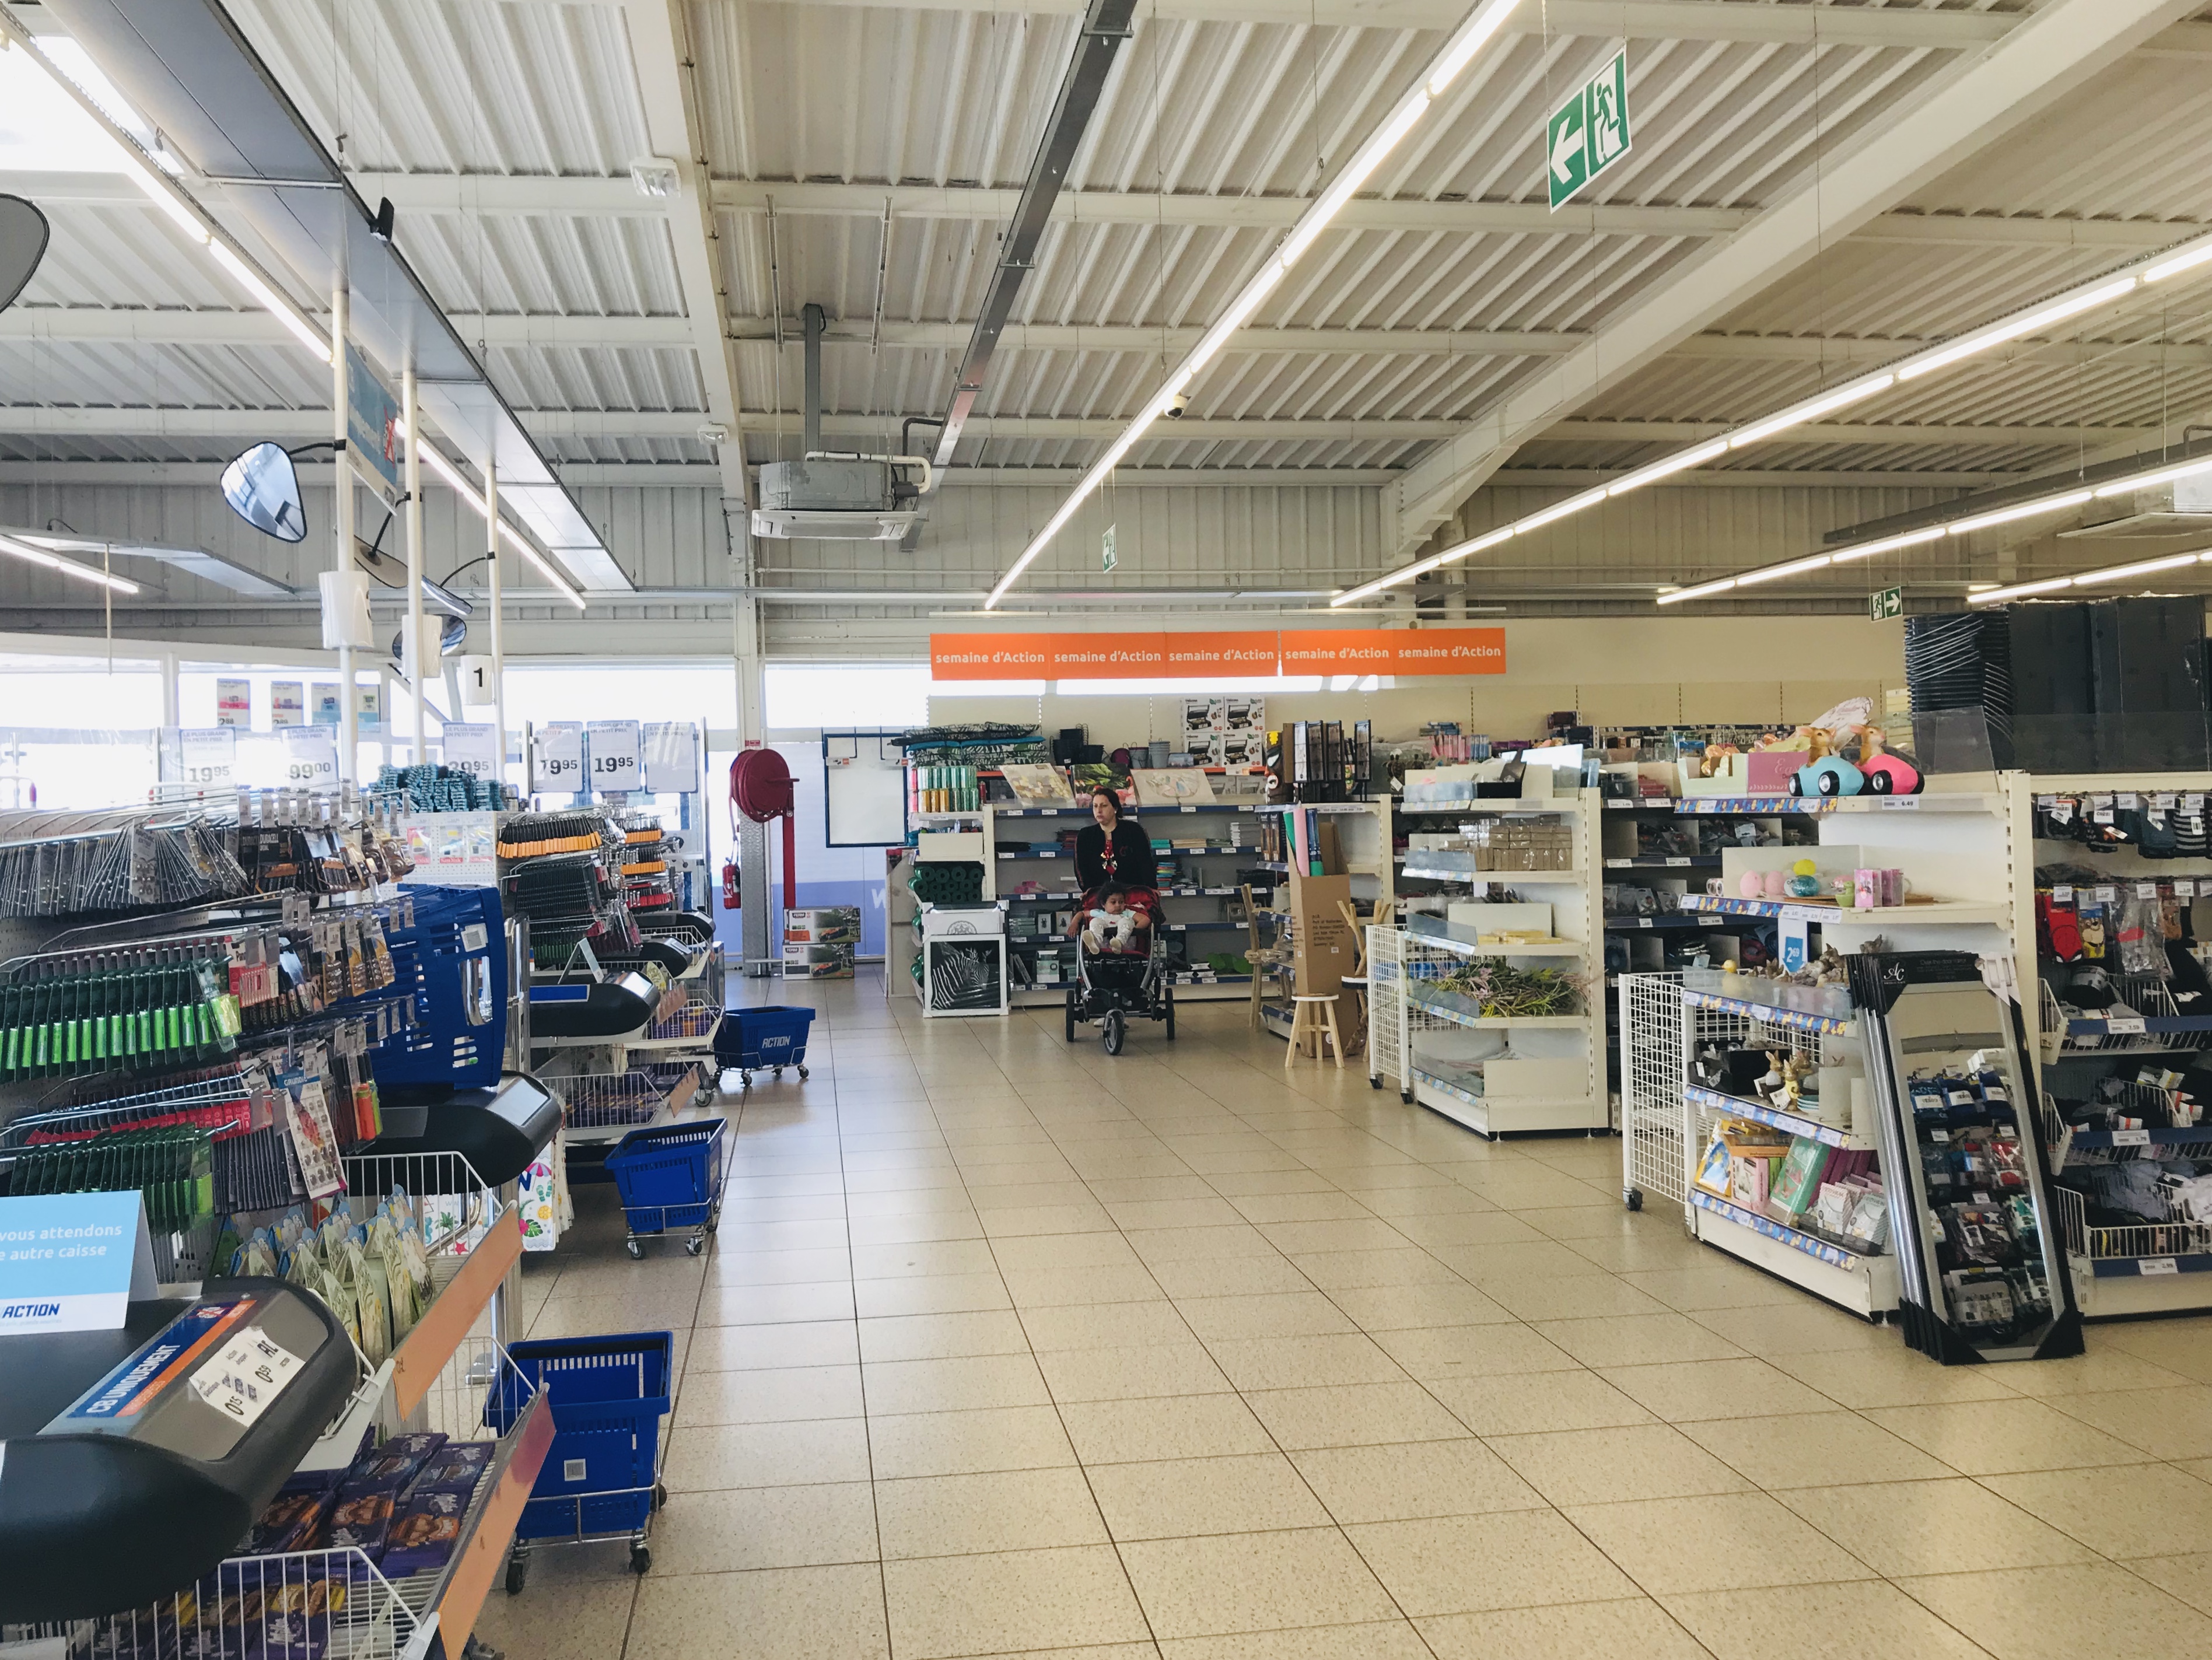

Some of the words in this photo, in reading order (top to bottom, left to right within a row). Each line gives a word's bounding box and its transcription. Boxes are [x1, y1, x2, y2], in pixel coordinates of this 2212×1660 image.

[935, 652, 989, 663] semaine
[992, 651, 1045, 663] d'Action
[1054, 651, 1107, 663] semaine
[1110, 650, 1161, 662] d'Action
[1168, 650, 1220, 661] semaine
[1223, 649, 1275, 660] d'Action
[1285, 648, 1335, 659] semaine
[1339, 647, 1390, 659] d'Action
[1398, 647, 1448, 657] semaine
[1451, 646, 1501, 656] d'Action
[474, 667, 482, 687] 1
[761, 1035, 790, 1048] ACTION
[40, 1224, 122, 1240] attendons
[10, 1247, 54, 1260] autre
[58, 1244, 107, 1258] caisse
[2, 1303, 61, 1319] ACTION
[86, 1399, 118, 1414] CB
[102, 1344, 181, 1401] UNIQUEMENT
